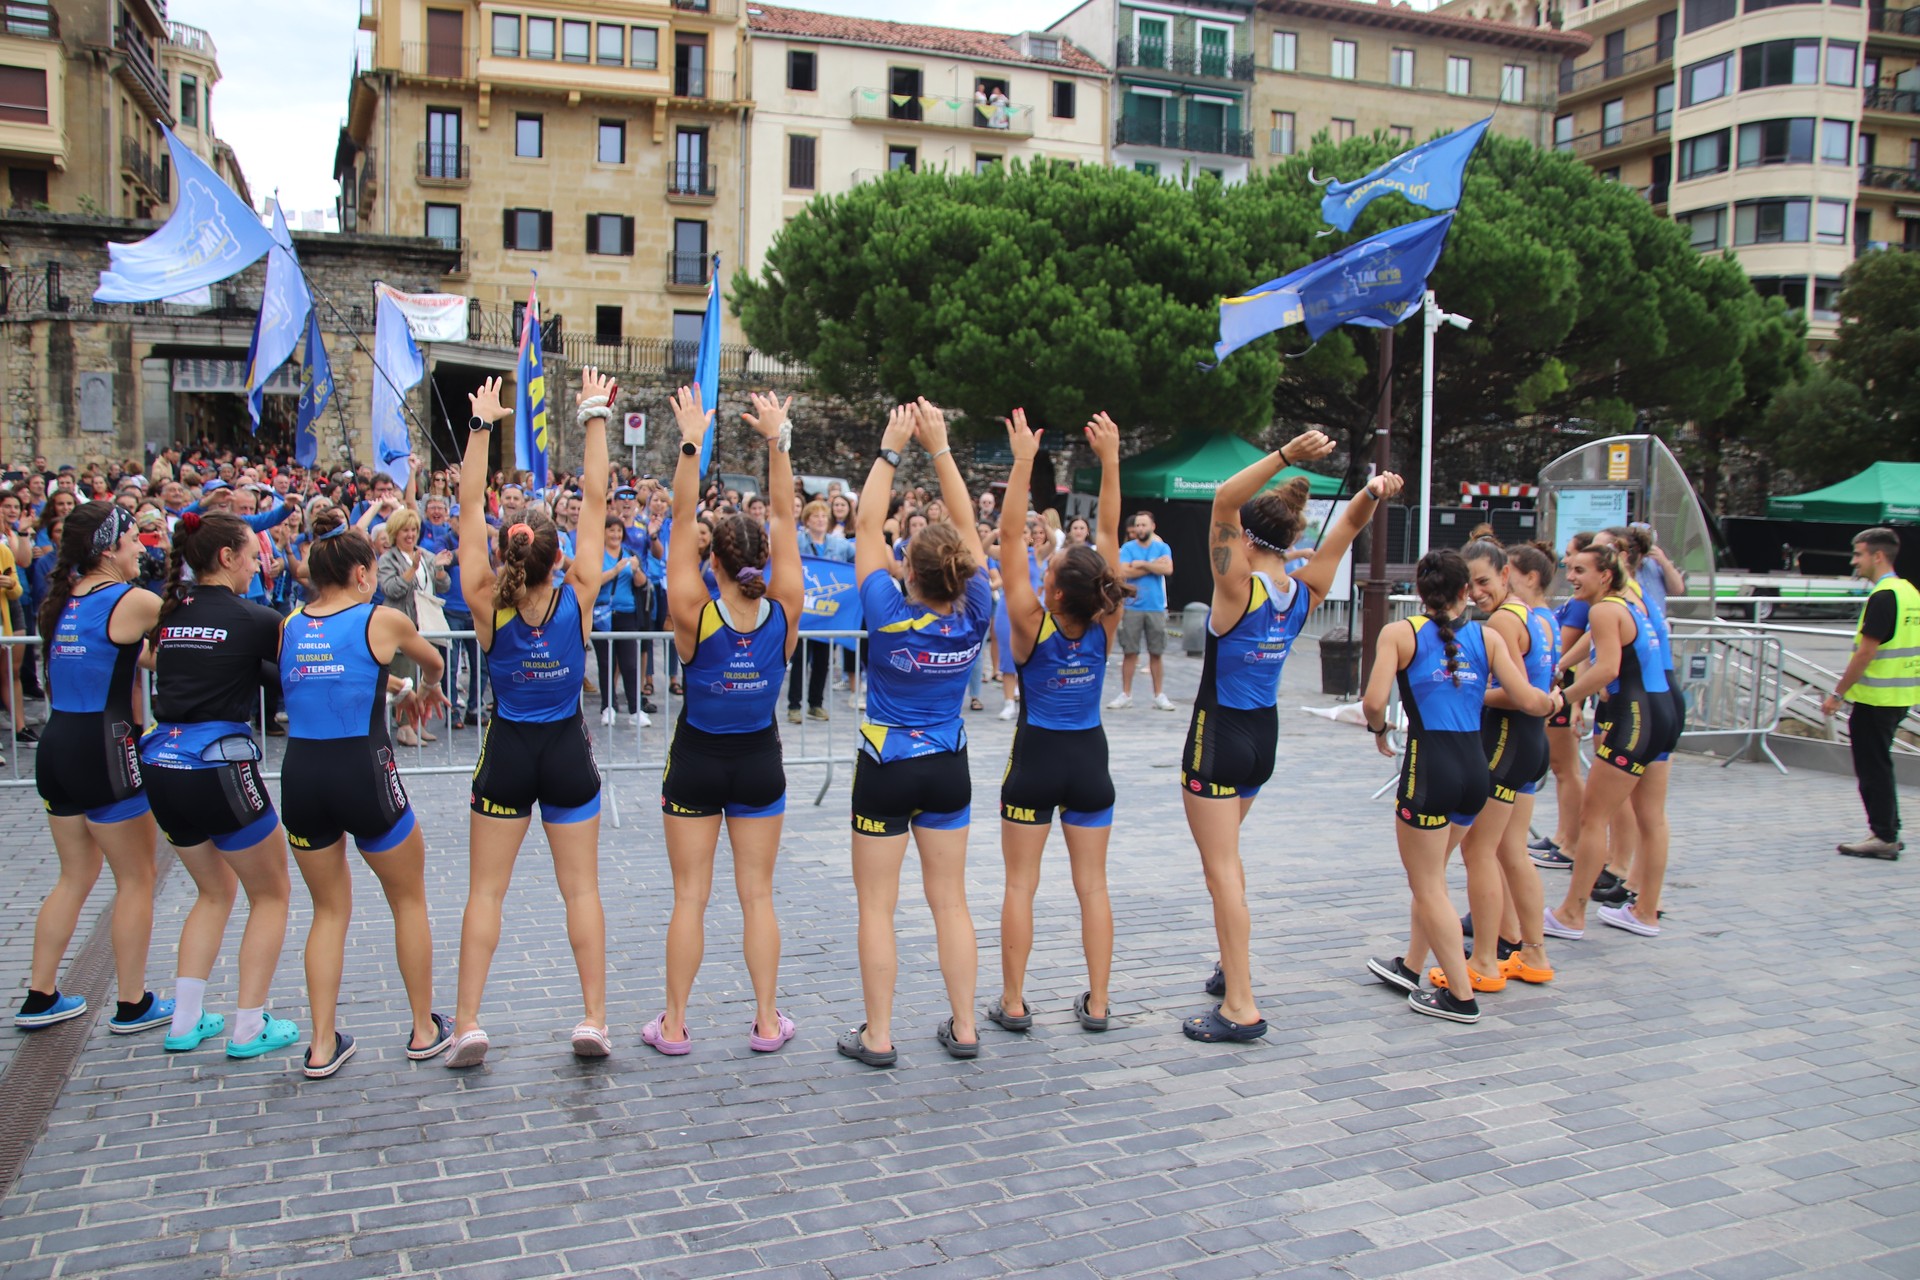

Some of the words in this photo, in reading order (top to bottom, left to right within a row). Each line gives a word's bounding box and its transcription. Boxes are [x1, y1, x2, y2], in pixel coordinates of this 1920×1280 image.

[1356, 269, 1379, 283] TAK
[161, 626, 228, 641] ATERPEA
[57, 645, 87, 653] ATERPEA
[531, 651, 550, 659] UXUE
[917, 642, 981, 663] ATERPEA
[296, 653, 334, 662] TOLOSALDEA
[522, 660, 561, 669] TOLOSALDEA
[300, 664, 345, 673] ATERPEA
[526, 667, 570, 678] ATERPEA
[723, 671, 760, 679] TOLOSALDEA
[726, 680, 768, 689] ATERPEA
[126, 736, 143, 788] ATERPEA
[388, 761, 406, 809] ATERPEA
[1494, 784, 1517, 802] TAK
[1006, 804, 1036, 822] TAK
[1417, 813, 1447, 827] TAK
[855, 815, 886, 833] TAK
